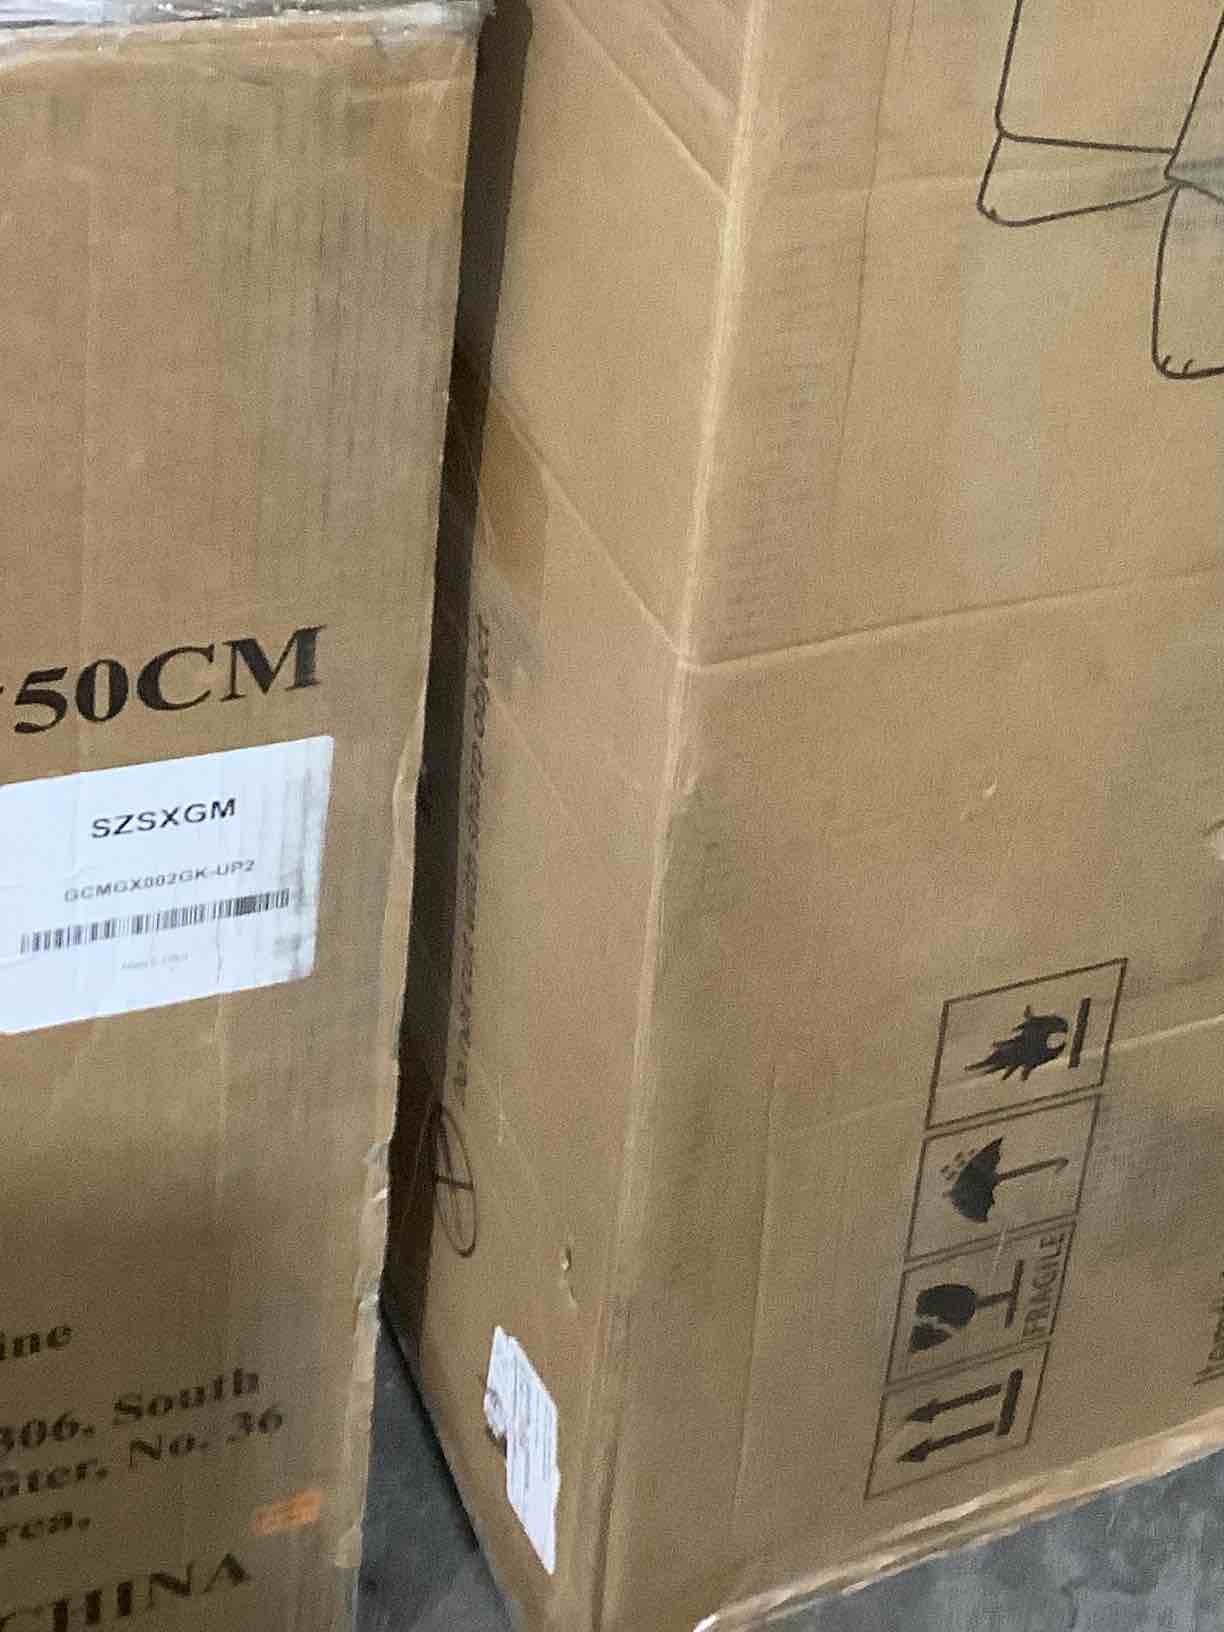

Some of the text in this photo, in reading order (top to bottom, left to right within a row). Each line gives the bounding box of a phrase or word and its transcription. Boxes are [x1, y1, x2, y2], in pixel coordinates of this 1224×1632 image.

[0, 625, 327, 734] 50CM
[91, 797, 237, 839] SZSXGM
[1022, 1231, 1066, 1341] FRAGILE
[112, 1368, 260, 1425] South
